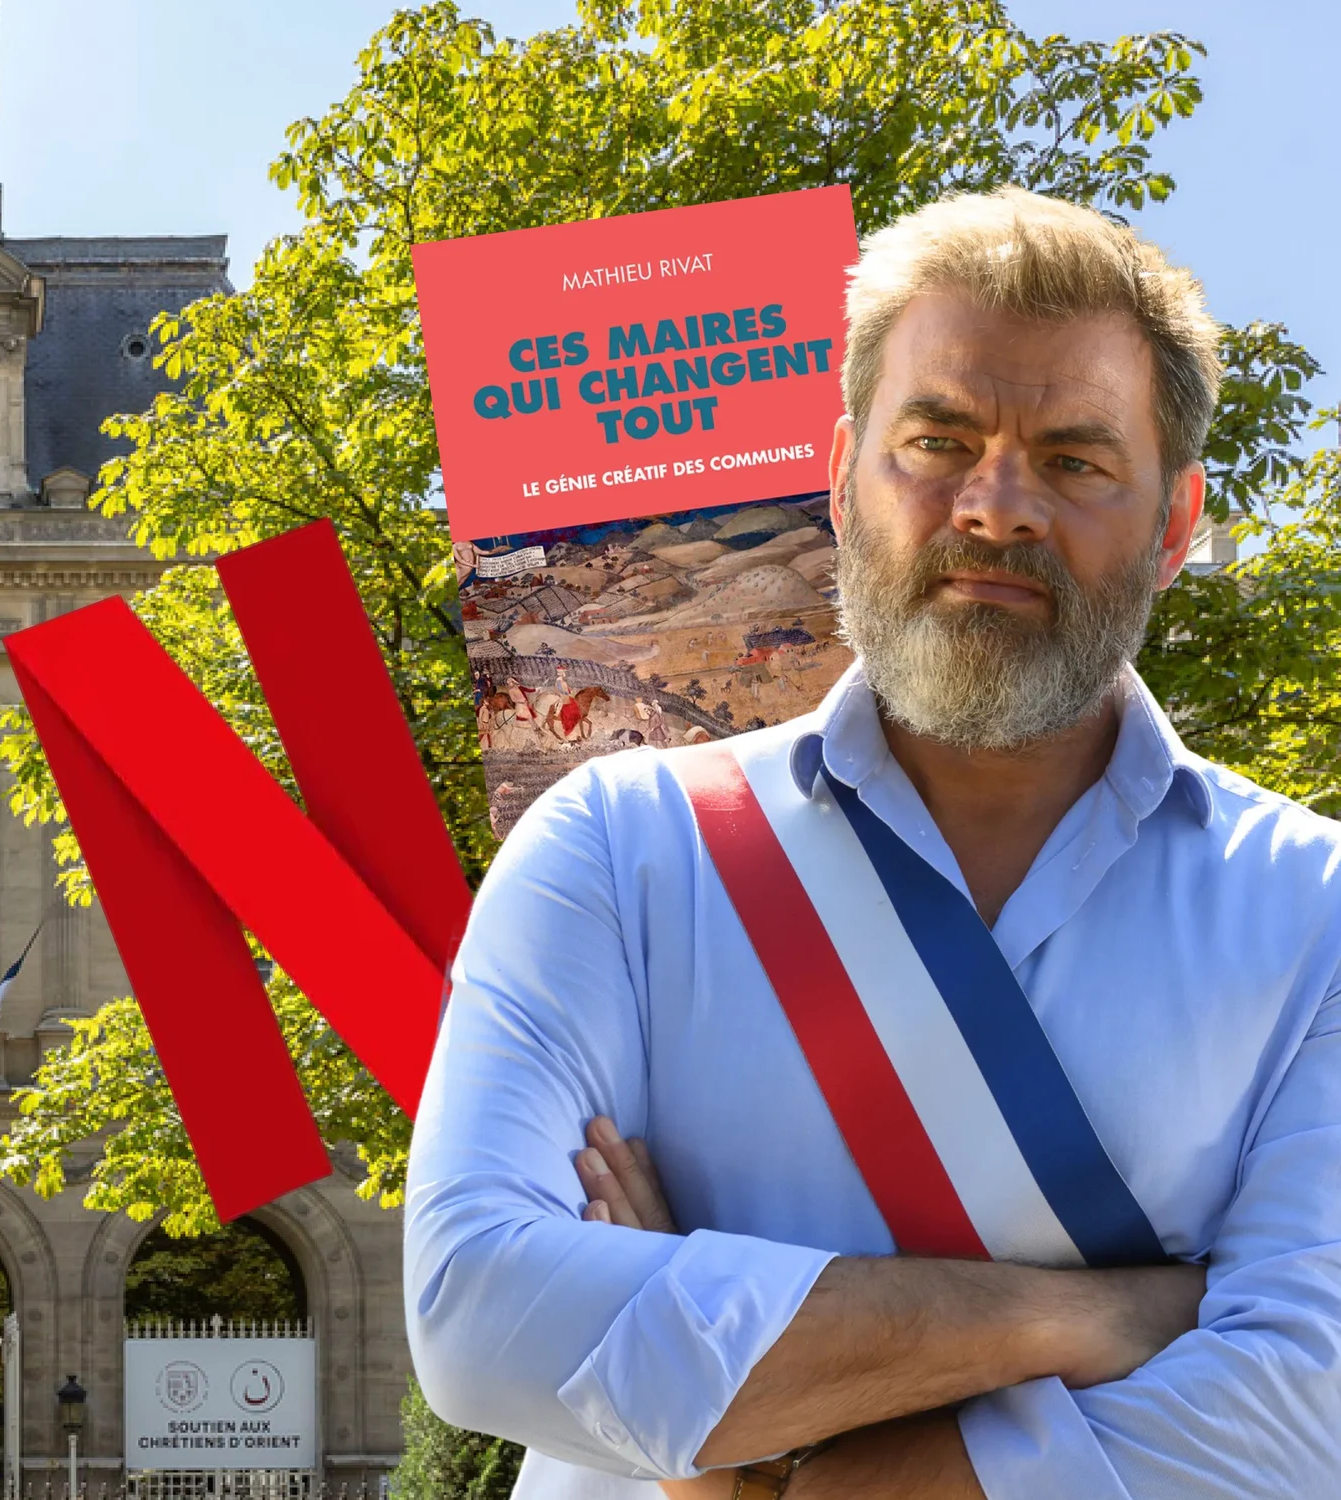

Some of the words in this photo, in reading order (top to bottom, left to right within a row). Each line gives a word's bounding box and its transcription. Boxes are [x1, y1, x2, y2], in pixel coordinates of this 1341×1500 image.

[562, 259, 653, 291] MATHIEU
[659, 253, 714, 277] RIVAT
[508, 331, 589, 373] CES
[608, 303, 787, 361] MAIRES
[473, 376, 561, 420] QUI
[578, 338, 833, 405] CHANGENT
[597, 396, 719, 444] TOUT
[522, 481, 541, 498] LE
[544, 474, 597, 494] GÉNIE
[602, 463, 669, 486] CRÉATIF
[673, 458, 706, 477] DES
[709, 442, 816, 472] COMMUNES
[138, 1434, 226, 1448] CHRÉTIENS
[167, 1420, 236, 1433] SOUTIEN
[240, 1420, 270, 1433] AUX
